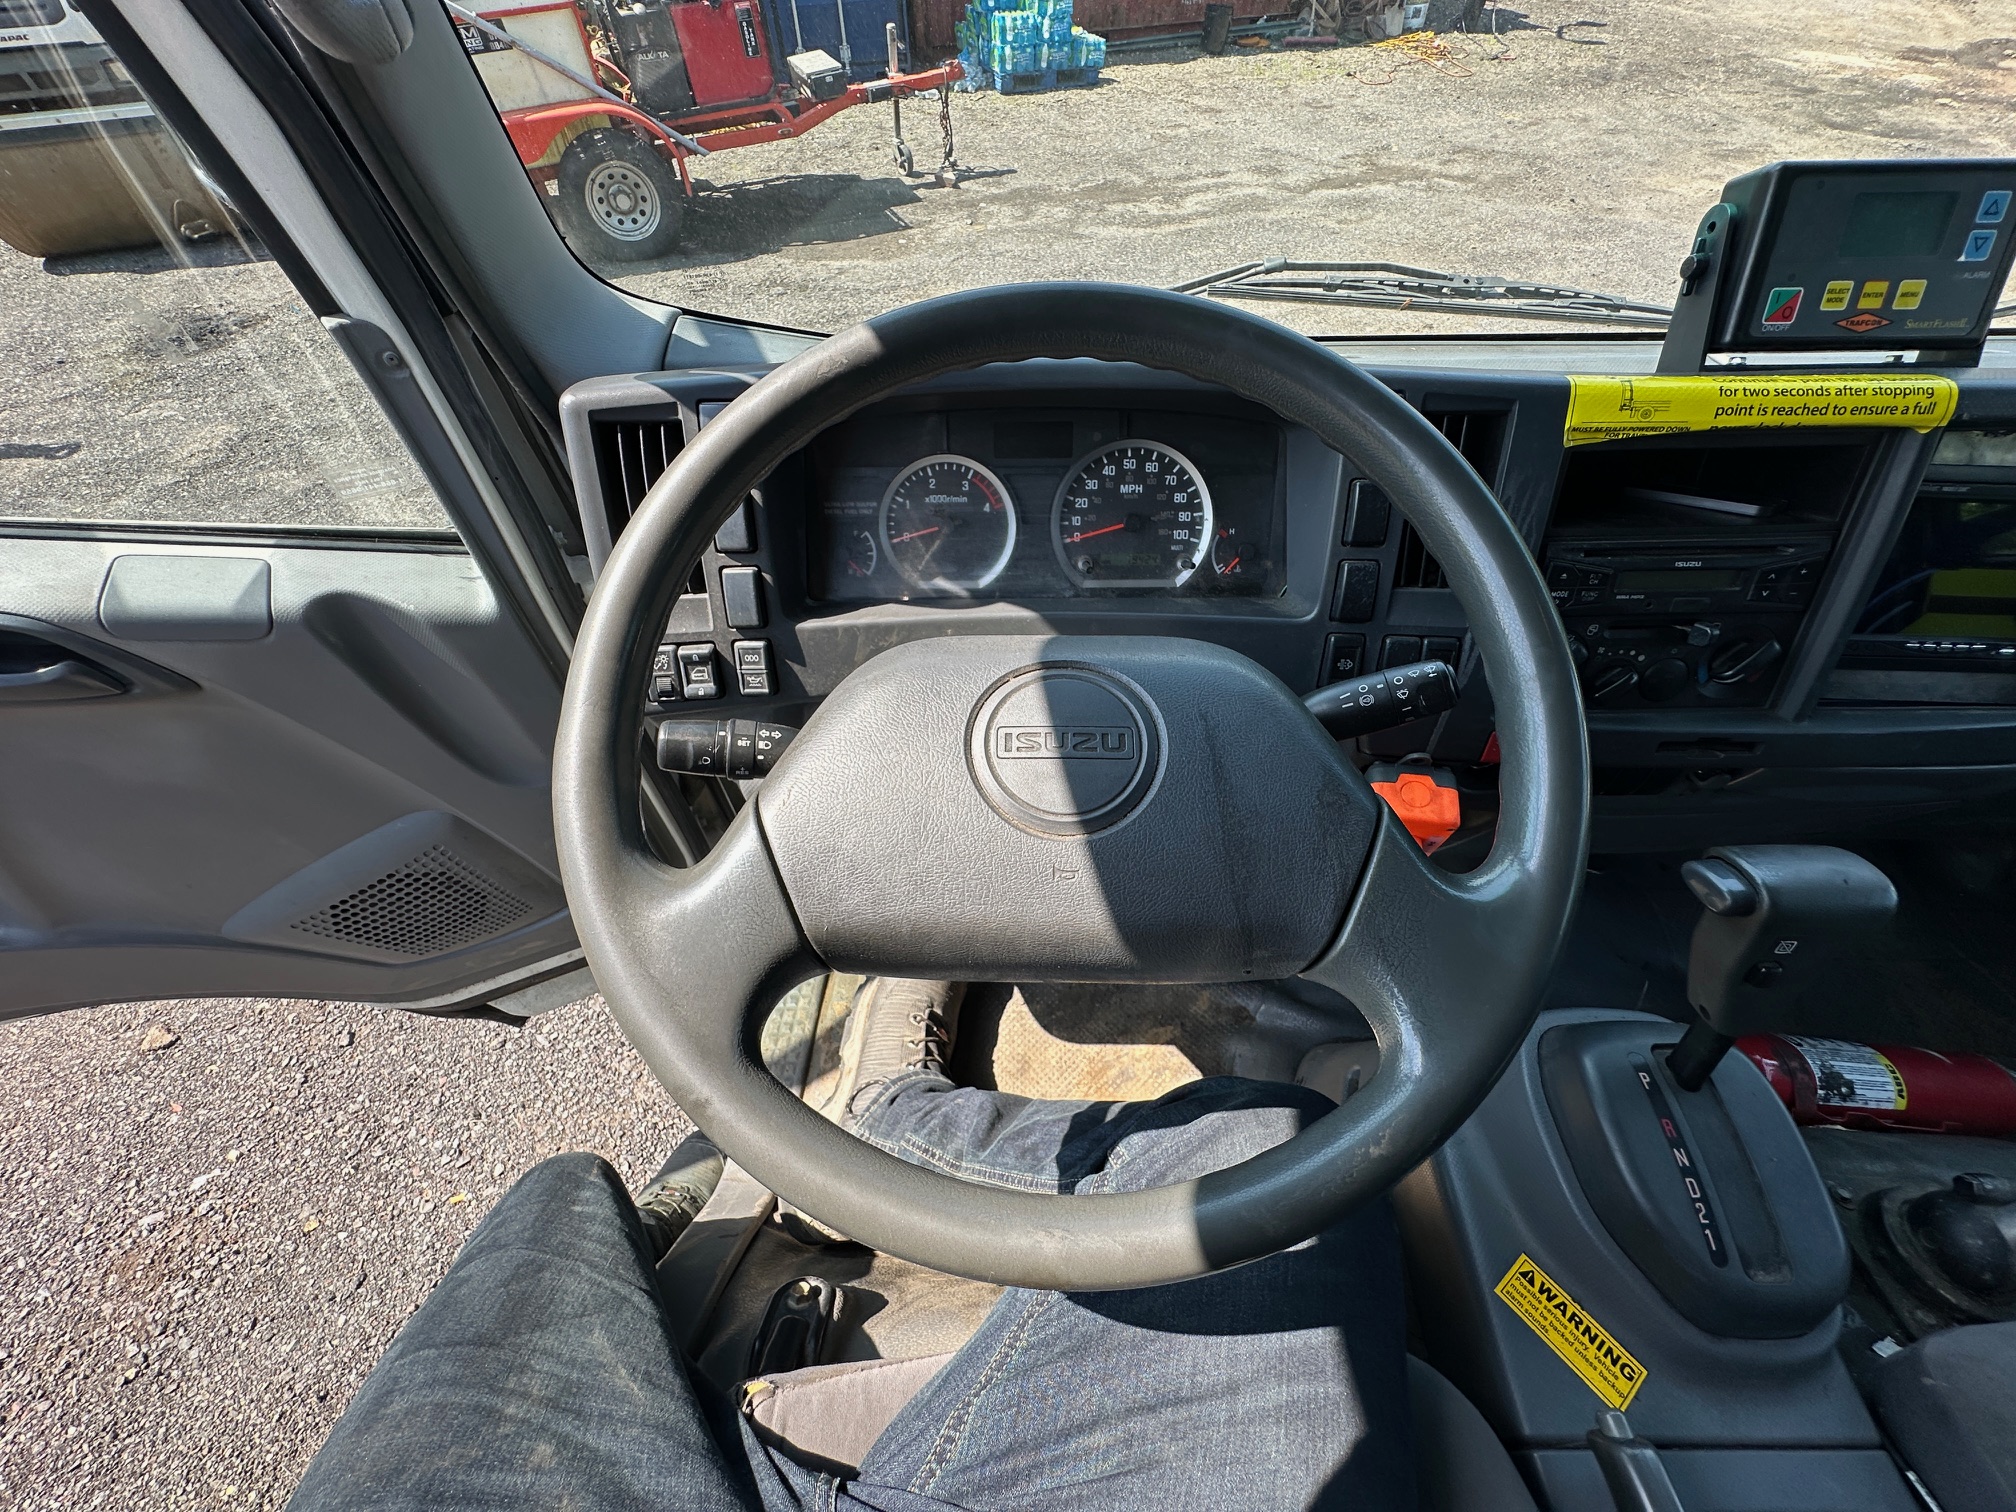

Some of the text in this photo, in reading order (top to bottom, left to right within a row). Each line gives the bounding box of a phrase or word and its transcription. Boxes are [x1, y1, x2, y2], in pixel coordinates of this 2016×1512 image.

[636, 50, 670, 60] ALKTA
[1963, 271, 1992, 279] ALARM
[1719, 385, 1934, 399] for two seconds after stopping
[1714, 402, 1937, 419] point is reached to ensure a full
[1123, 459, 1136, 469] 50
[1145, 462, 1158, 472] 60
[1102, 466, 1115, 475] 40
[929, 479, 935, 488] 2
[1085, 480, 1098, 489] 30
[1164, 475, 1177, 485] 70
[962, 481, 969, 490] 3
[1120, 484, 1143, 493] MPH
[1075, 498, 1088, 508] 20
[1174, 493, 1187, 503] 80
[983, 503, 990, 512] 4
[1072, 516, 1081, 526] 10
[1179, 512, 1191, 521] 90
[1074, 532, 1080, 542] 0
[1173, 530, 1189, 539] 100
[1004, 732, 1128, 753] ISUZU
[1638, 1072, 1650, 1090] P
[1661, 1118, 1677, 1138] R
[1673, 1148, 1690, 1167] N
[1685, 1178, 1701, 1198] D
[1695, 1203, 1709, 1223] 2
[1704, 1229, 1716, 1251] 1
[1505, 1289, 1524, 1309] alarm
[1515, 1276, 1543, 1305] Possible
[1543, 1305, 1568, 1331] serious
[1594, 1352, 1619, 1381] Vehicle
[1538, 1281, 1637, 1383] WARNING
[1510, 1283, 1625, 1399] must not be backed unless backup
